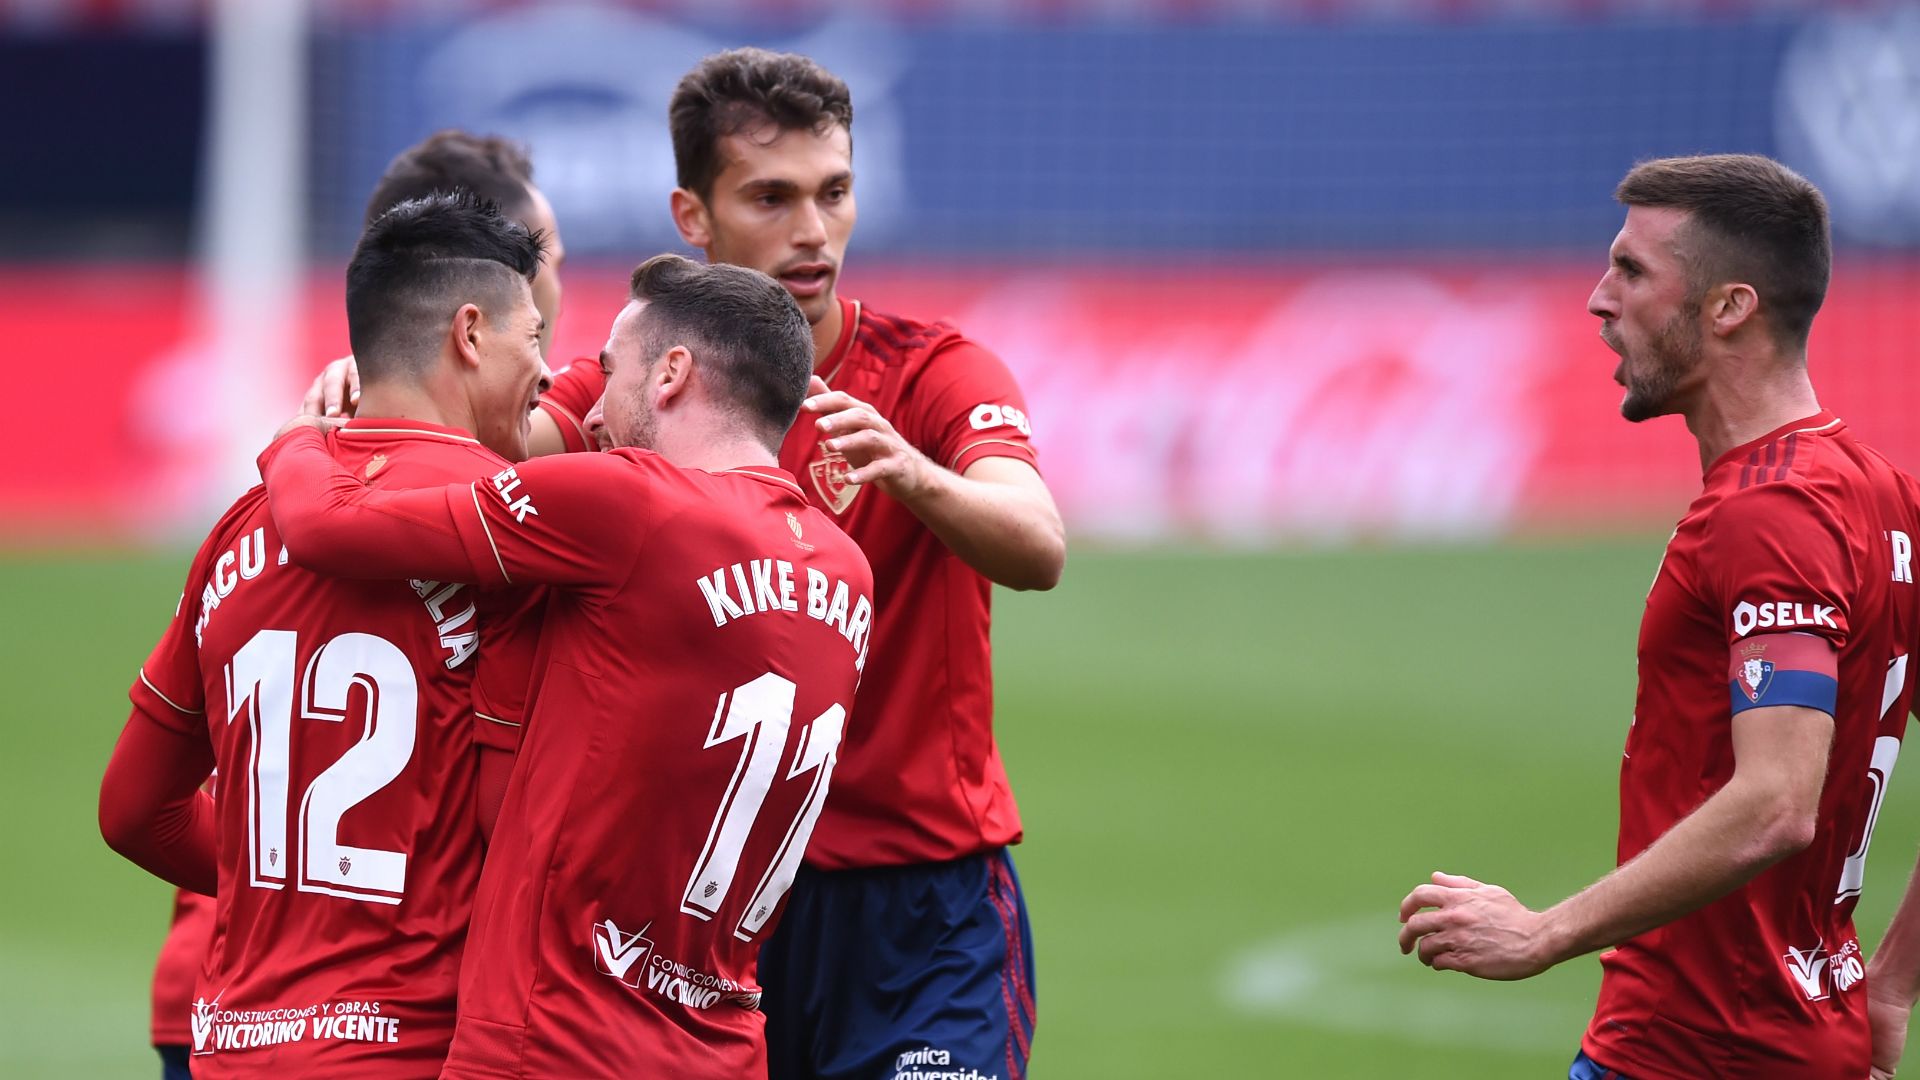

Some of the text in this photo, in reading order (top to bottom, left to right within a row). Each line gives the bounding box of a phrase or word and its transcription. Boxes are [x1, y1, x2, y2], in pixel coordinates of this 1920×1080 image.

[697, 559, 872, 673] KIKE BAR
[1733, 601, 1838, 636] OSELK
[224, 629, 419, 905] 12
[679, 672, 846, 942] 11
[215, 1002, 380, 1024] CONSTRUCCIONES Y OBRAS
[215, 1014, 400, 1050] VICTORINO VICENTE
